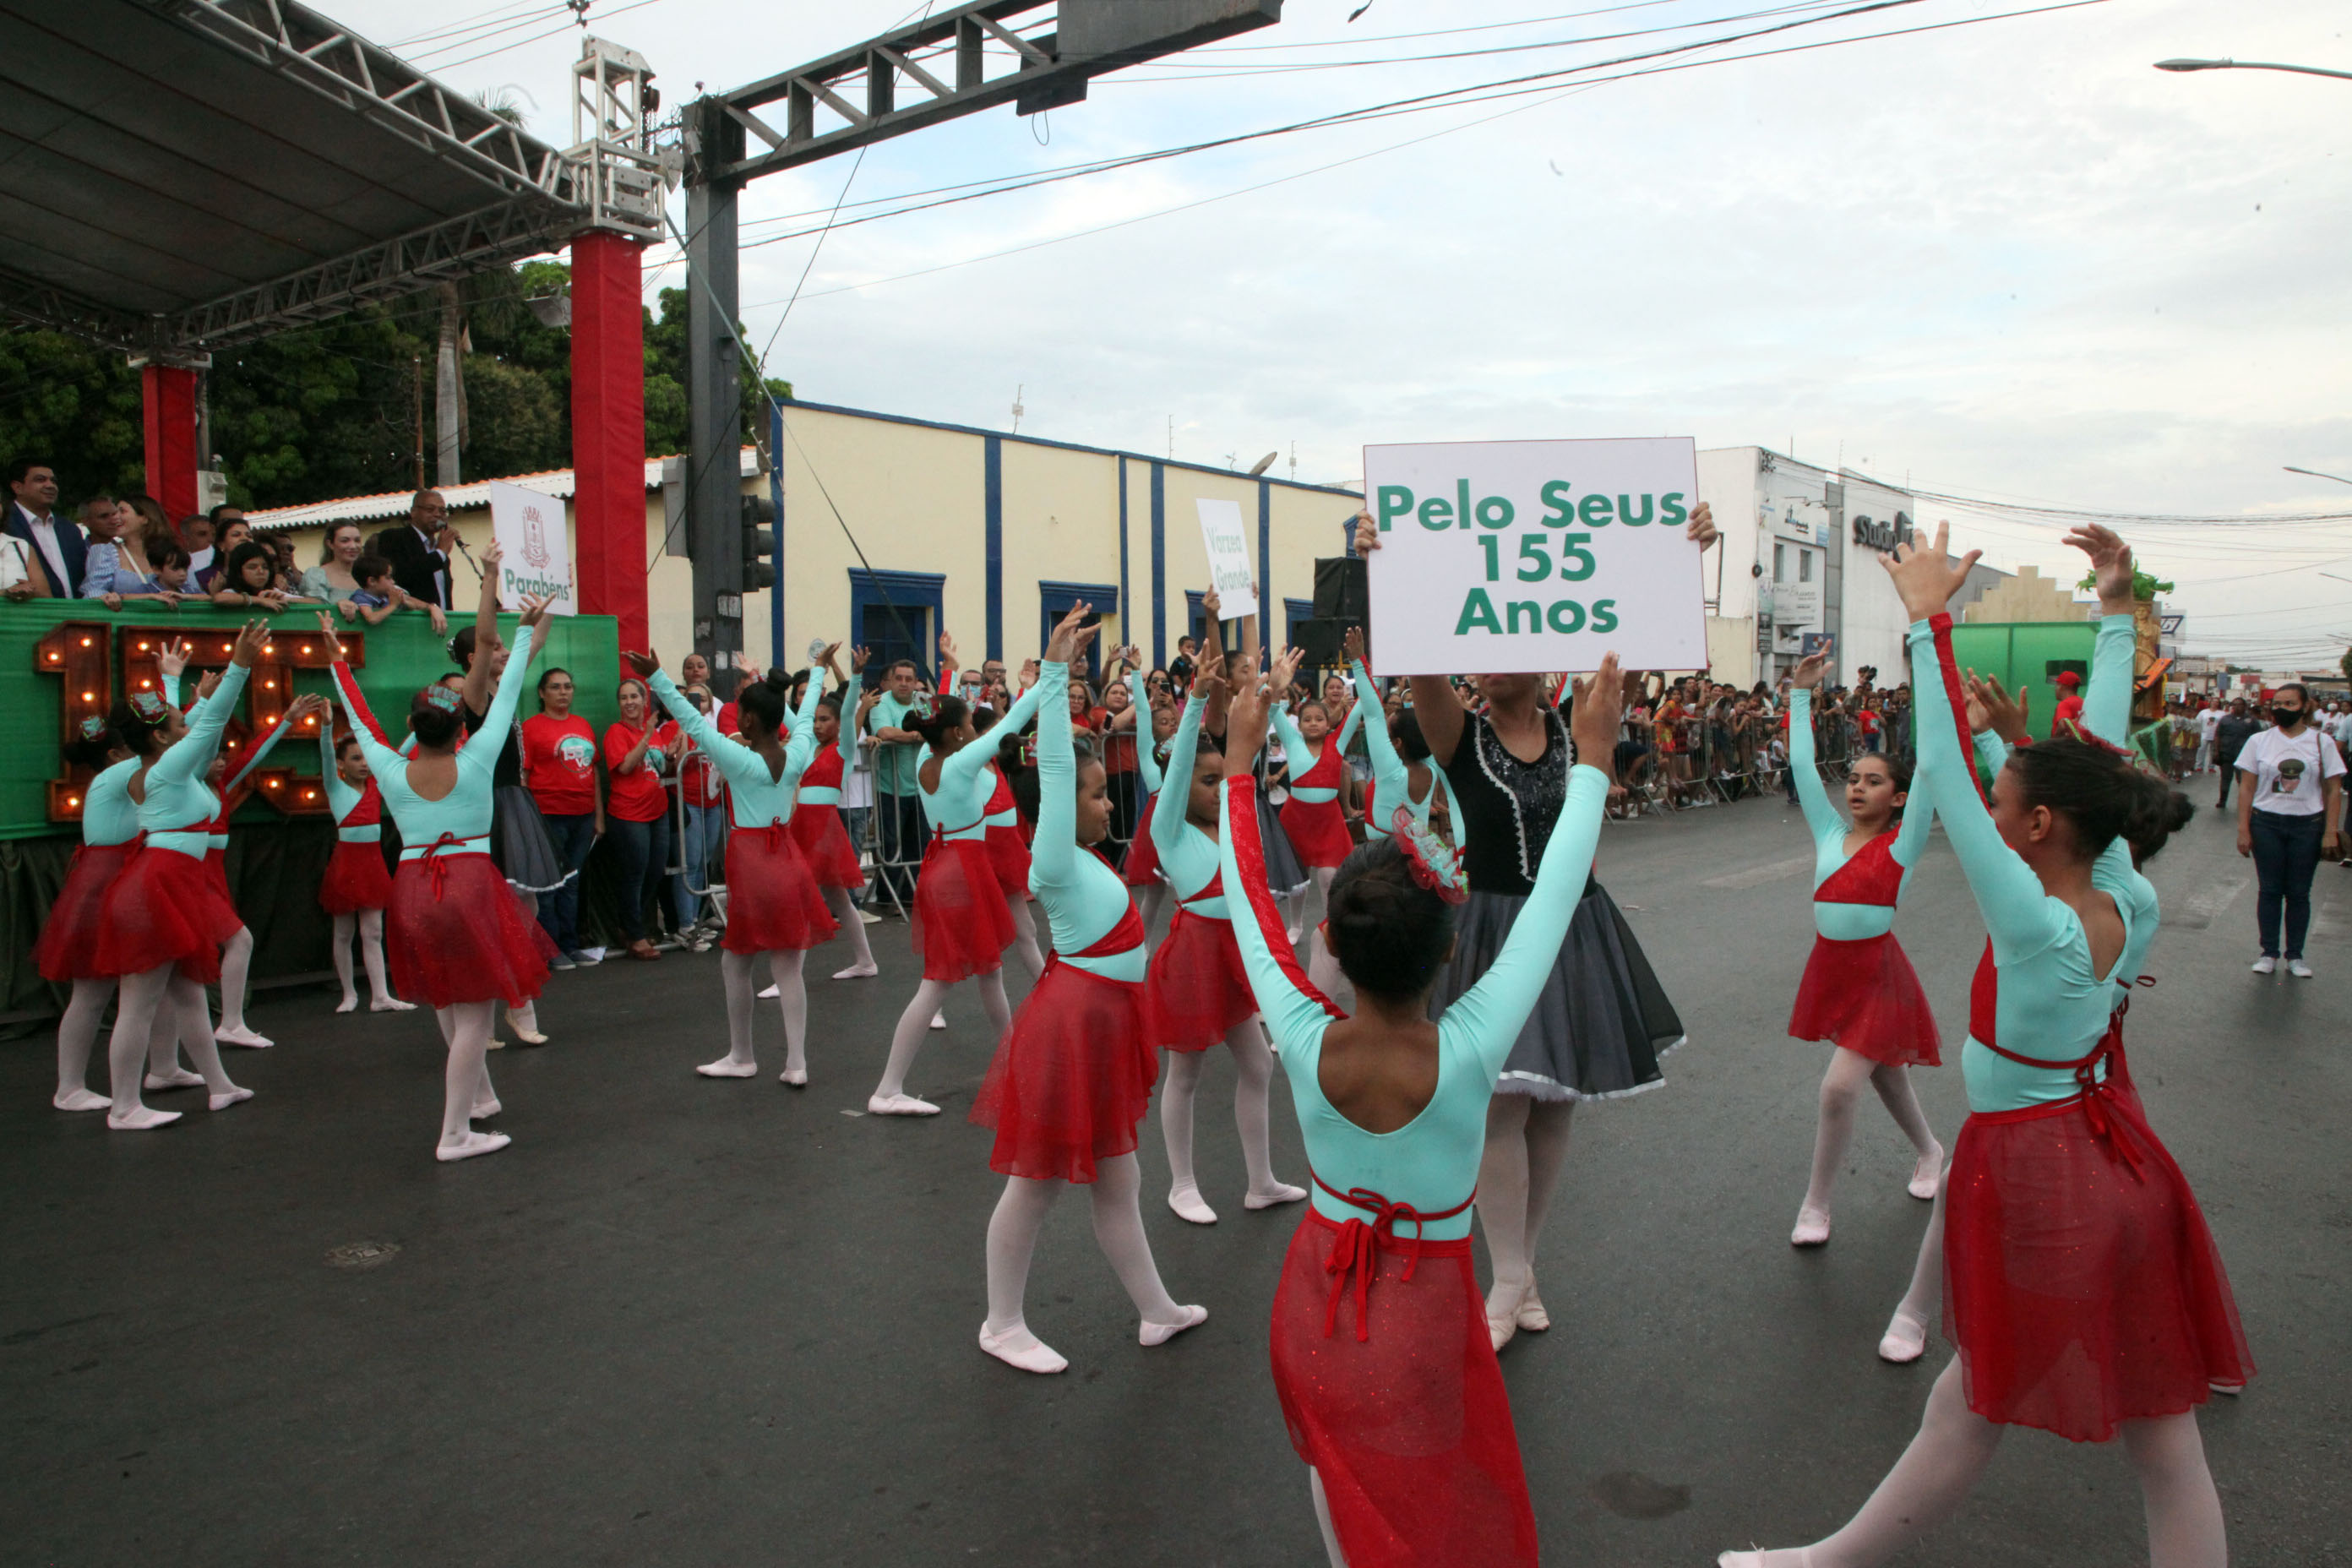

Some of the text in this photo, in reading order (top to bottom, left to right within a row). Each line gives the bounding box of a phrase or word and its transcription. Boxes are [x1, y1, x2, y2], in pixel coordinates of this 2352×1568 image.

[1379, 478, 1687, 531] Pelo Seus
[1216, 561, 1250, 591] Grande
[1478, 533, 1595, 581] 155
[504, 568, 569, 602] Parabéns
[1456, 588, 1619, 634] Anos
